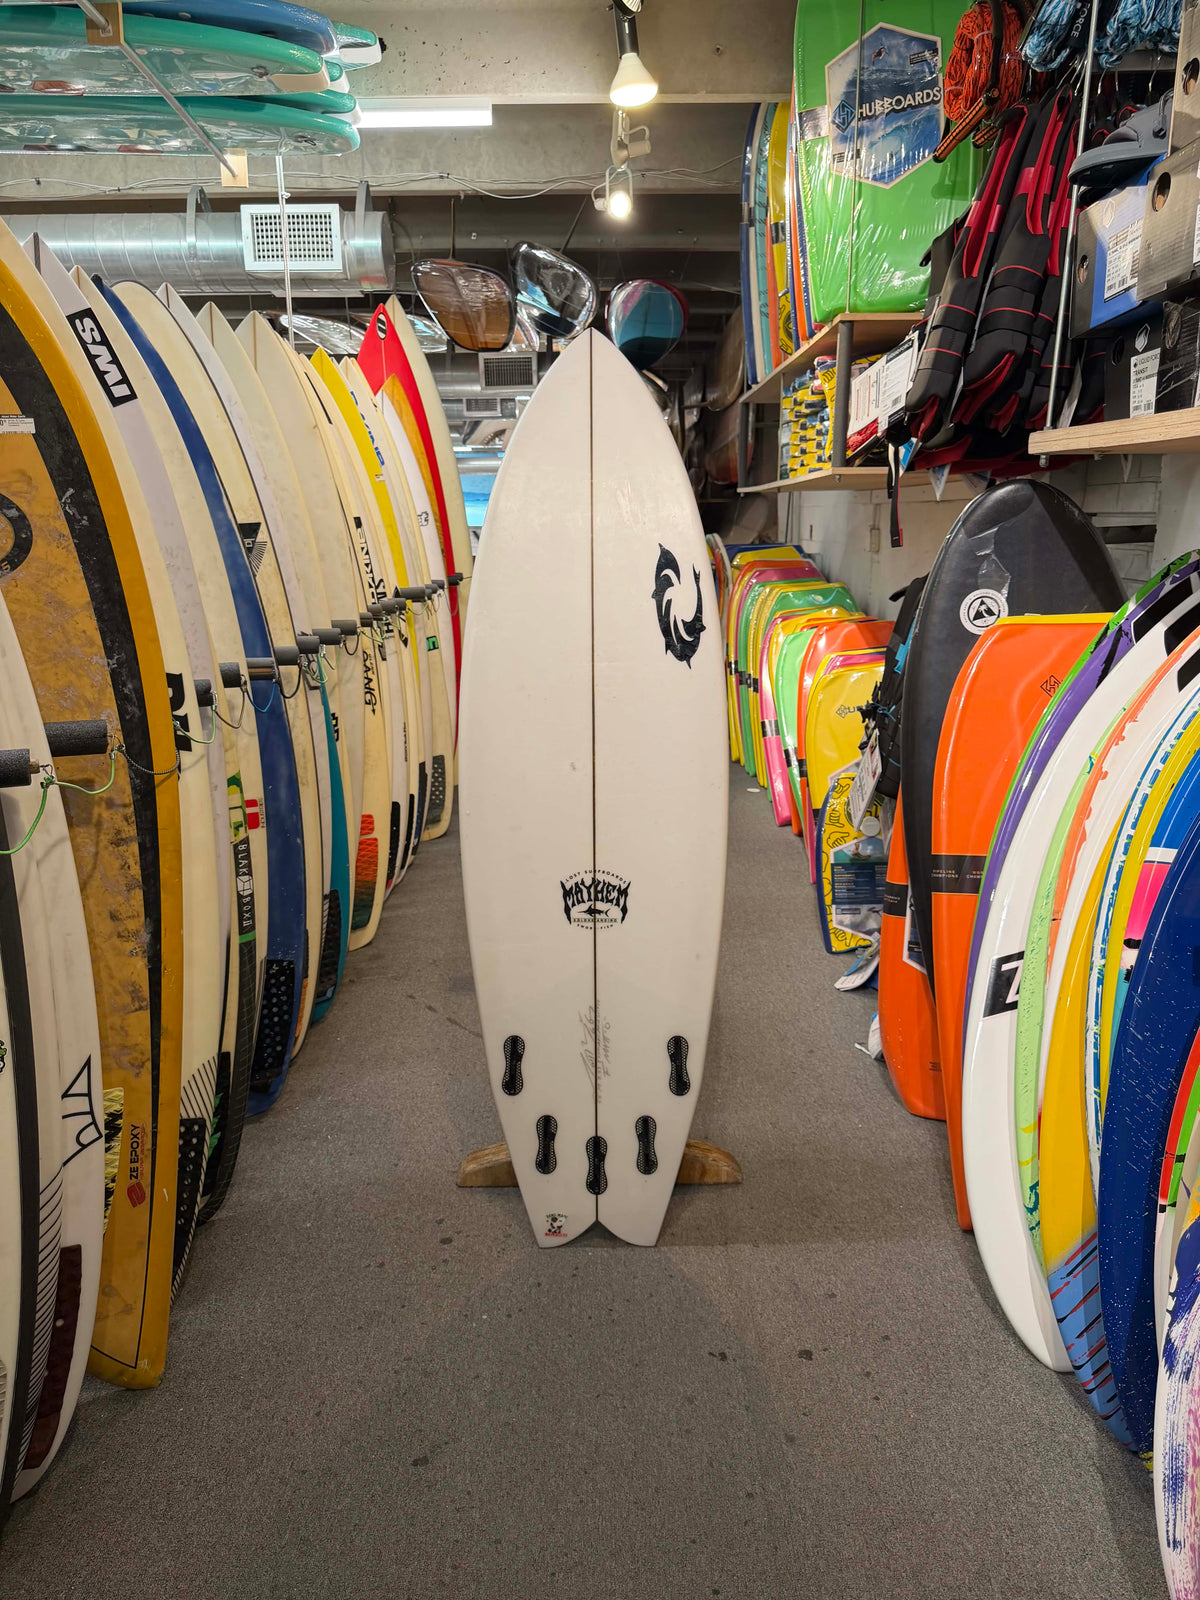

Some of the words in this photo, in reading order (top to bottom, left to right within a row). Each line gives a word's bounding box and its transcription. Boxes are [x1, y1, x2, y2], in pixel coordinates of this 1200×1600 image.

[857, 86, 943, 118] HUBBOARDS
[75, 317, 131, 398] SMI
[238, 843, 249, 875] BLAK
[560, 876, 632, 925] MAYHEM
[130, 1123, 140, 1164] EPOXY
[129, 1166, 139, 1181] ZE
